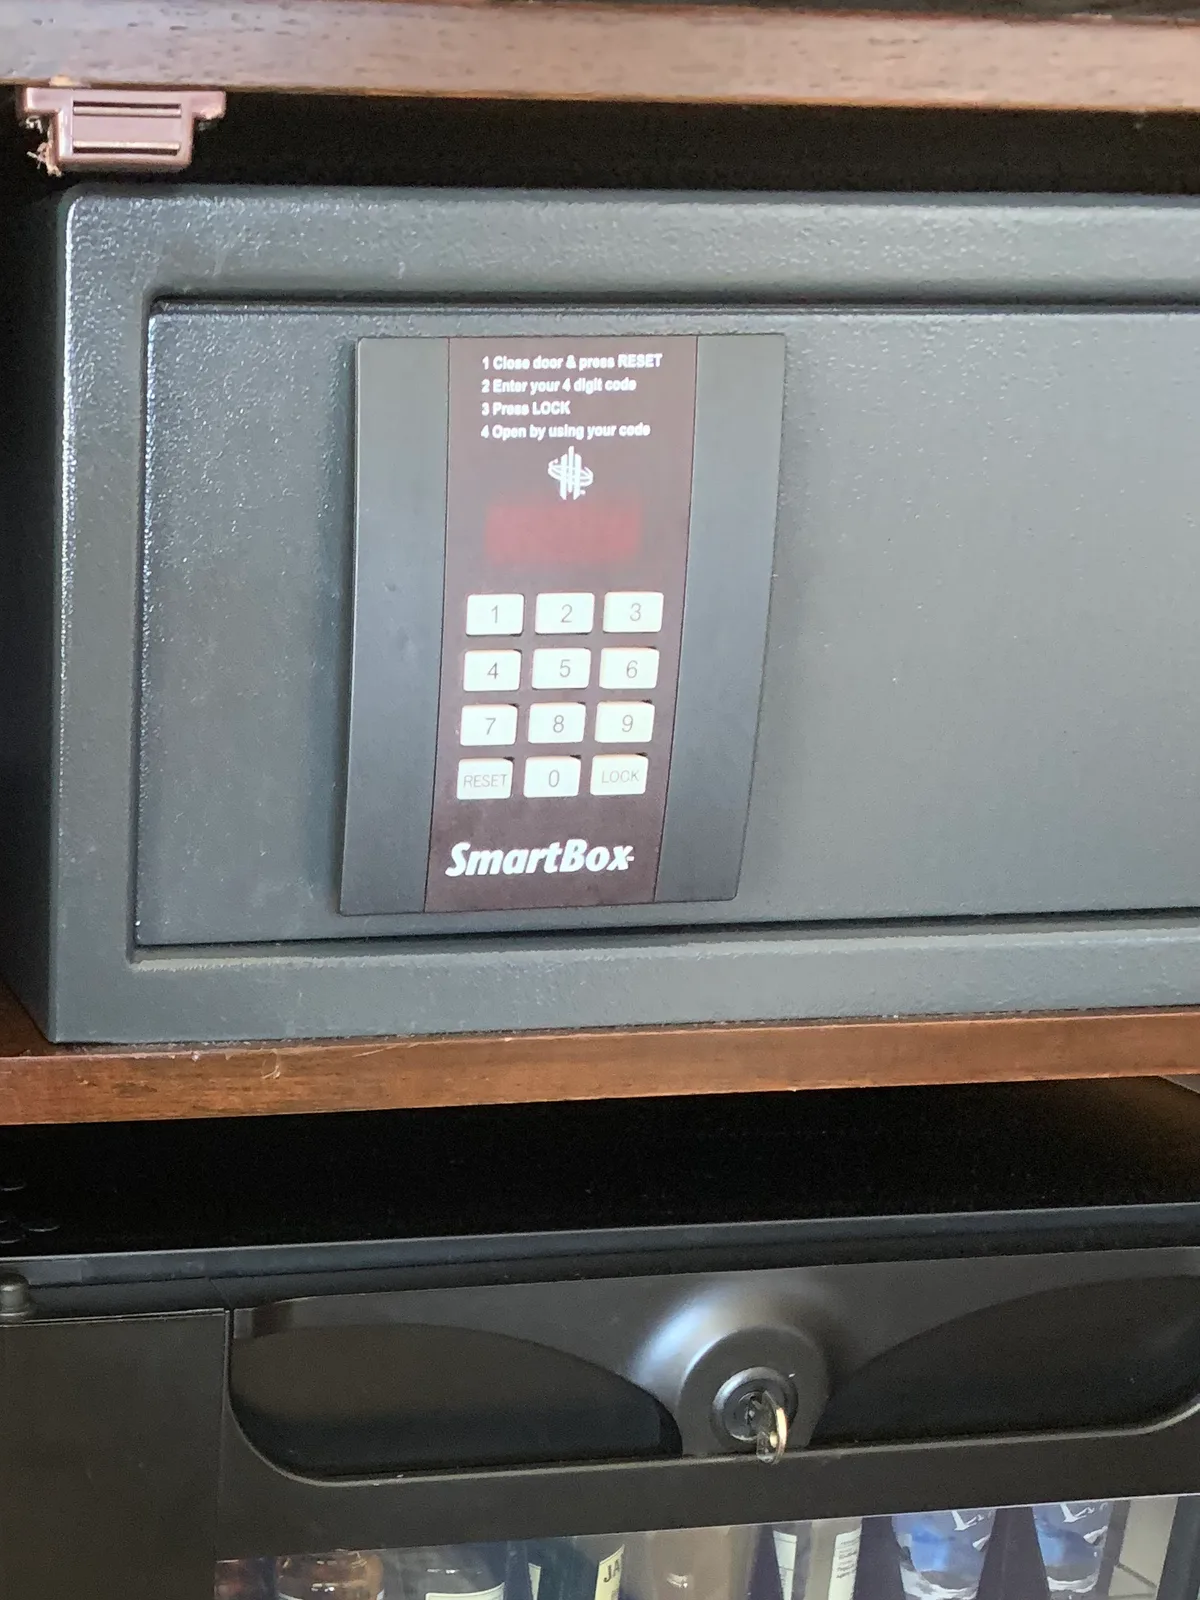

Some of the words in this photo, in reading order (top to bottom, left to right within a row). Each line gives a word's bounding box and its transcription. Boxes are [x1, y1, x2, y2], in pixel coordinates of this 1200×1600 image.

[482, 356, 489, 370] 1
[493, 356, 530, 370] Close
[533, 355, 564, 369] door
[566, 355, 576, 369] &
[579, 356, 615, 371] press
[618, 353, 663, 368] RESET
[481, 379, 490, 393] 2
[493, 379, 528, 393] Enter
[530, 380, 560, 395] your
[562, 378, 571, 392] 4
[573, 377, 603, 395] digit
[605, 377, 637, 391] code
[481, 402, 490, 416] 3
[493, 402, 530, 416] Press
[532, 400, 571, 415] LOCK
[481, 425, 490, 439] 4
[492, 424, 527, 441] Open
[530, 424, 546, 441] by
[548, 424, 585, 441] using
[587, 424, 617, 440] your
[618, 422, 651, 437] code
[491, 605, 499, 624] 1
[560, 604, 573, 623] 2
[629, 603, 642, 622] 3
[487, 662, 499, 679] 4
[559, 659, 571, 678] 5
[626, 660, 638, 679] 6
[485, 718, 496, 735] 7
[553, 715, 565, 733] 8
[621, 714, 634, 732] 9
[463, 773, 508, 788] RESET
[548, 770, 560, 788] 0
[601, 770, 640, 784] LOCK
[445, 838, 634, 877] SmartBox
